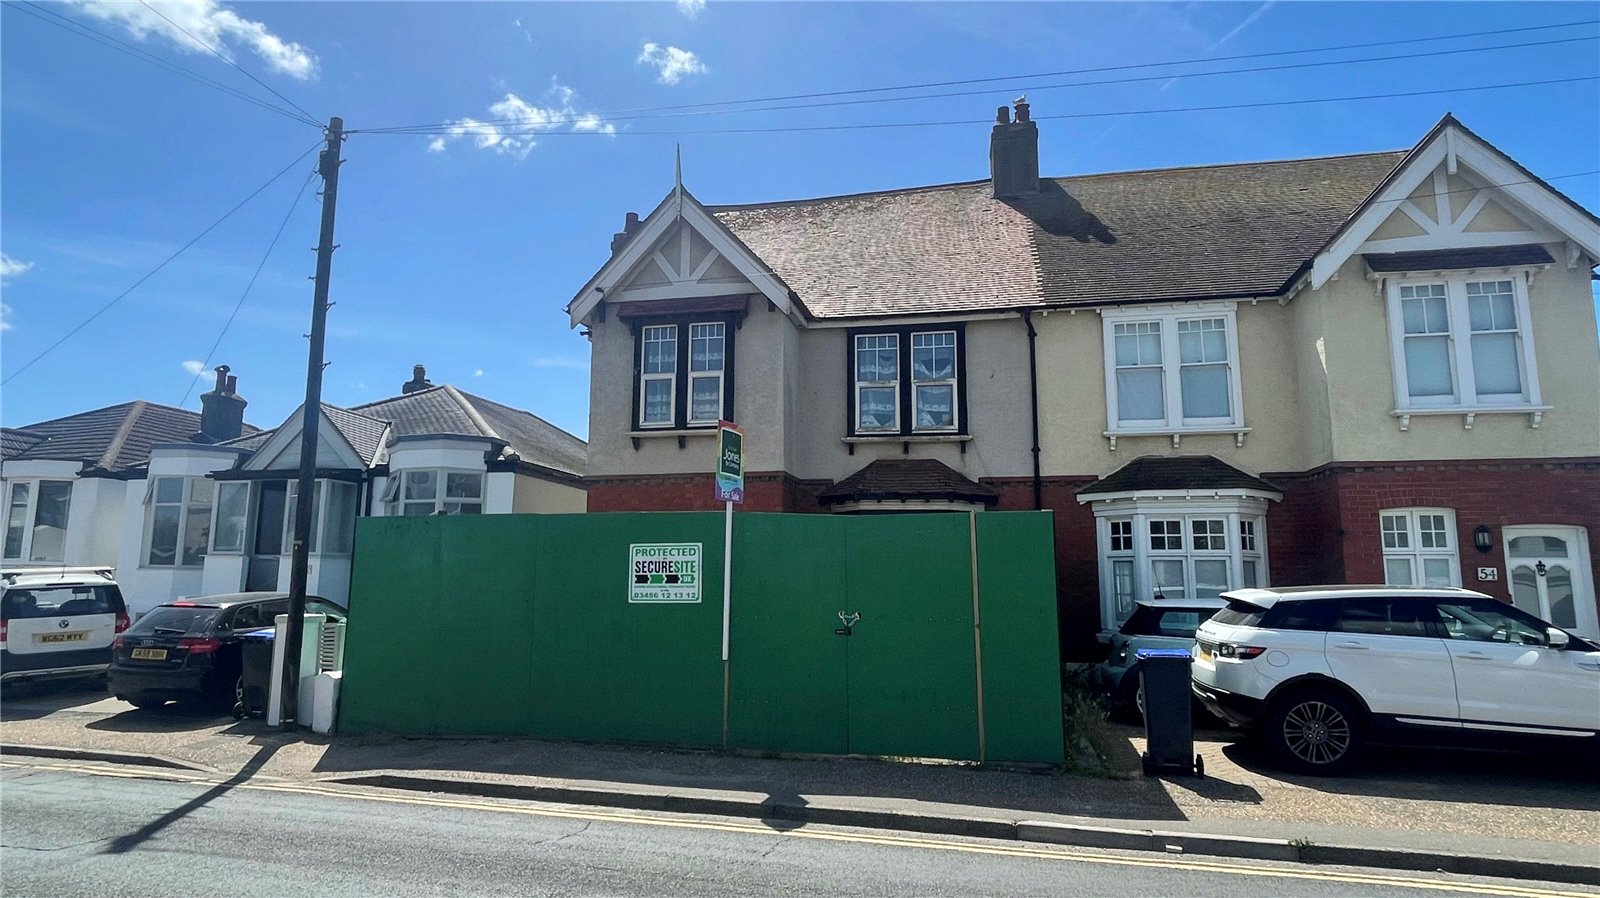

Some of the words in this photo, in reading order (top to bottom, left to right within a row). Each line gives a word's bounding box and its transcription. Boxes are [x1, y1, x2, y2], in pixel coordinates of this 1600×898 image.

[723, 449, 740, 463] Jones
[721, 489, 730, 500] For
[731, 491, 739, 501] Sale
[635, 548, 696, 556] PROTECTED
[635, 561, 696, 573] SECURESITE
[683, 575, 692, 583] UK
[1479, 569, 1497, 580] 54
